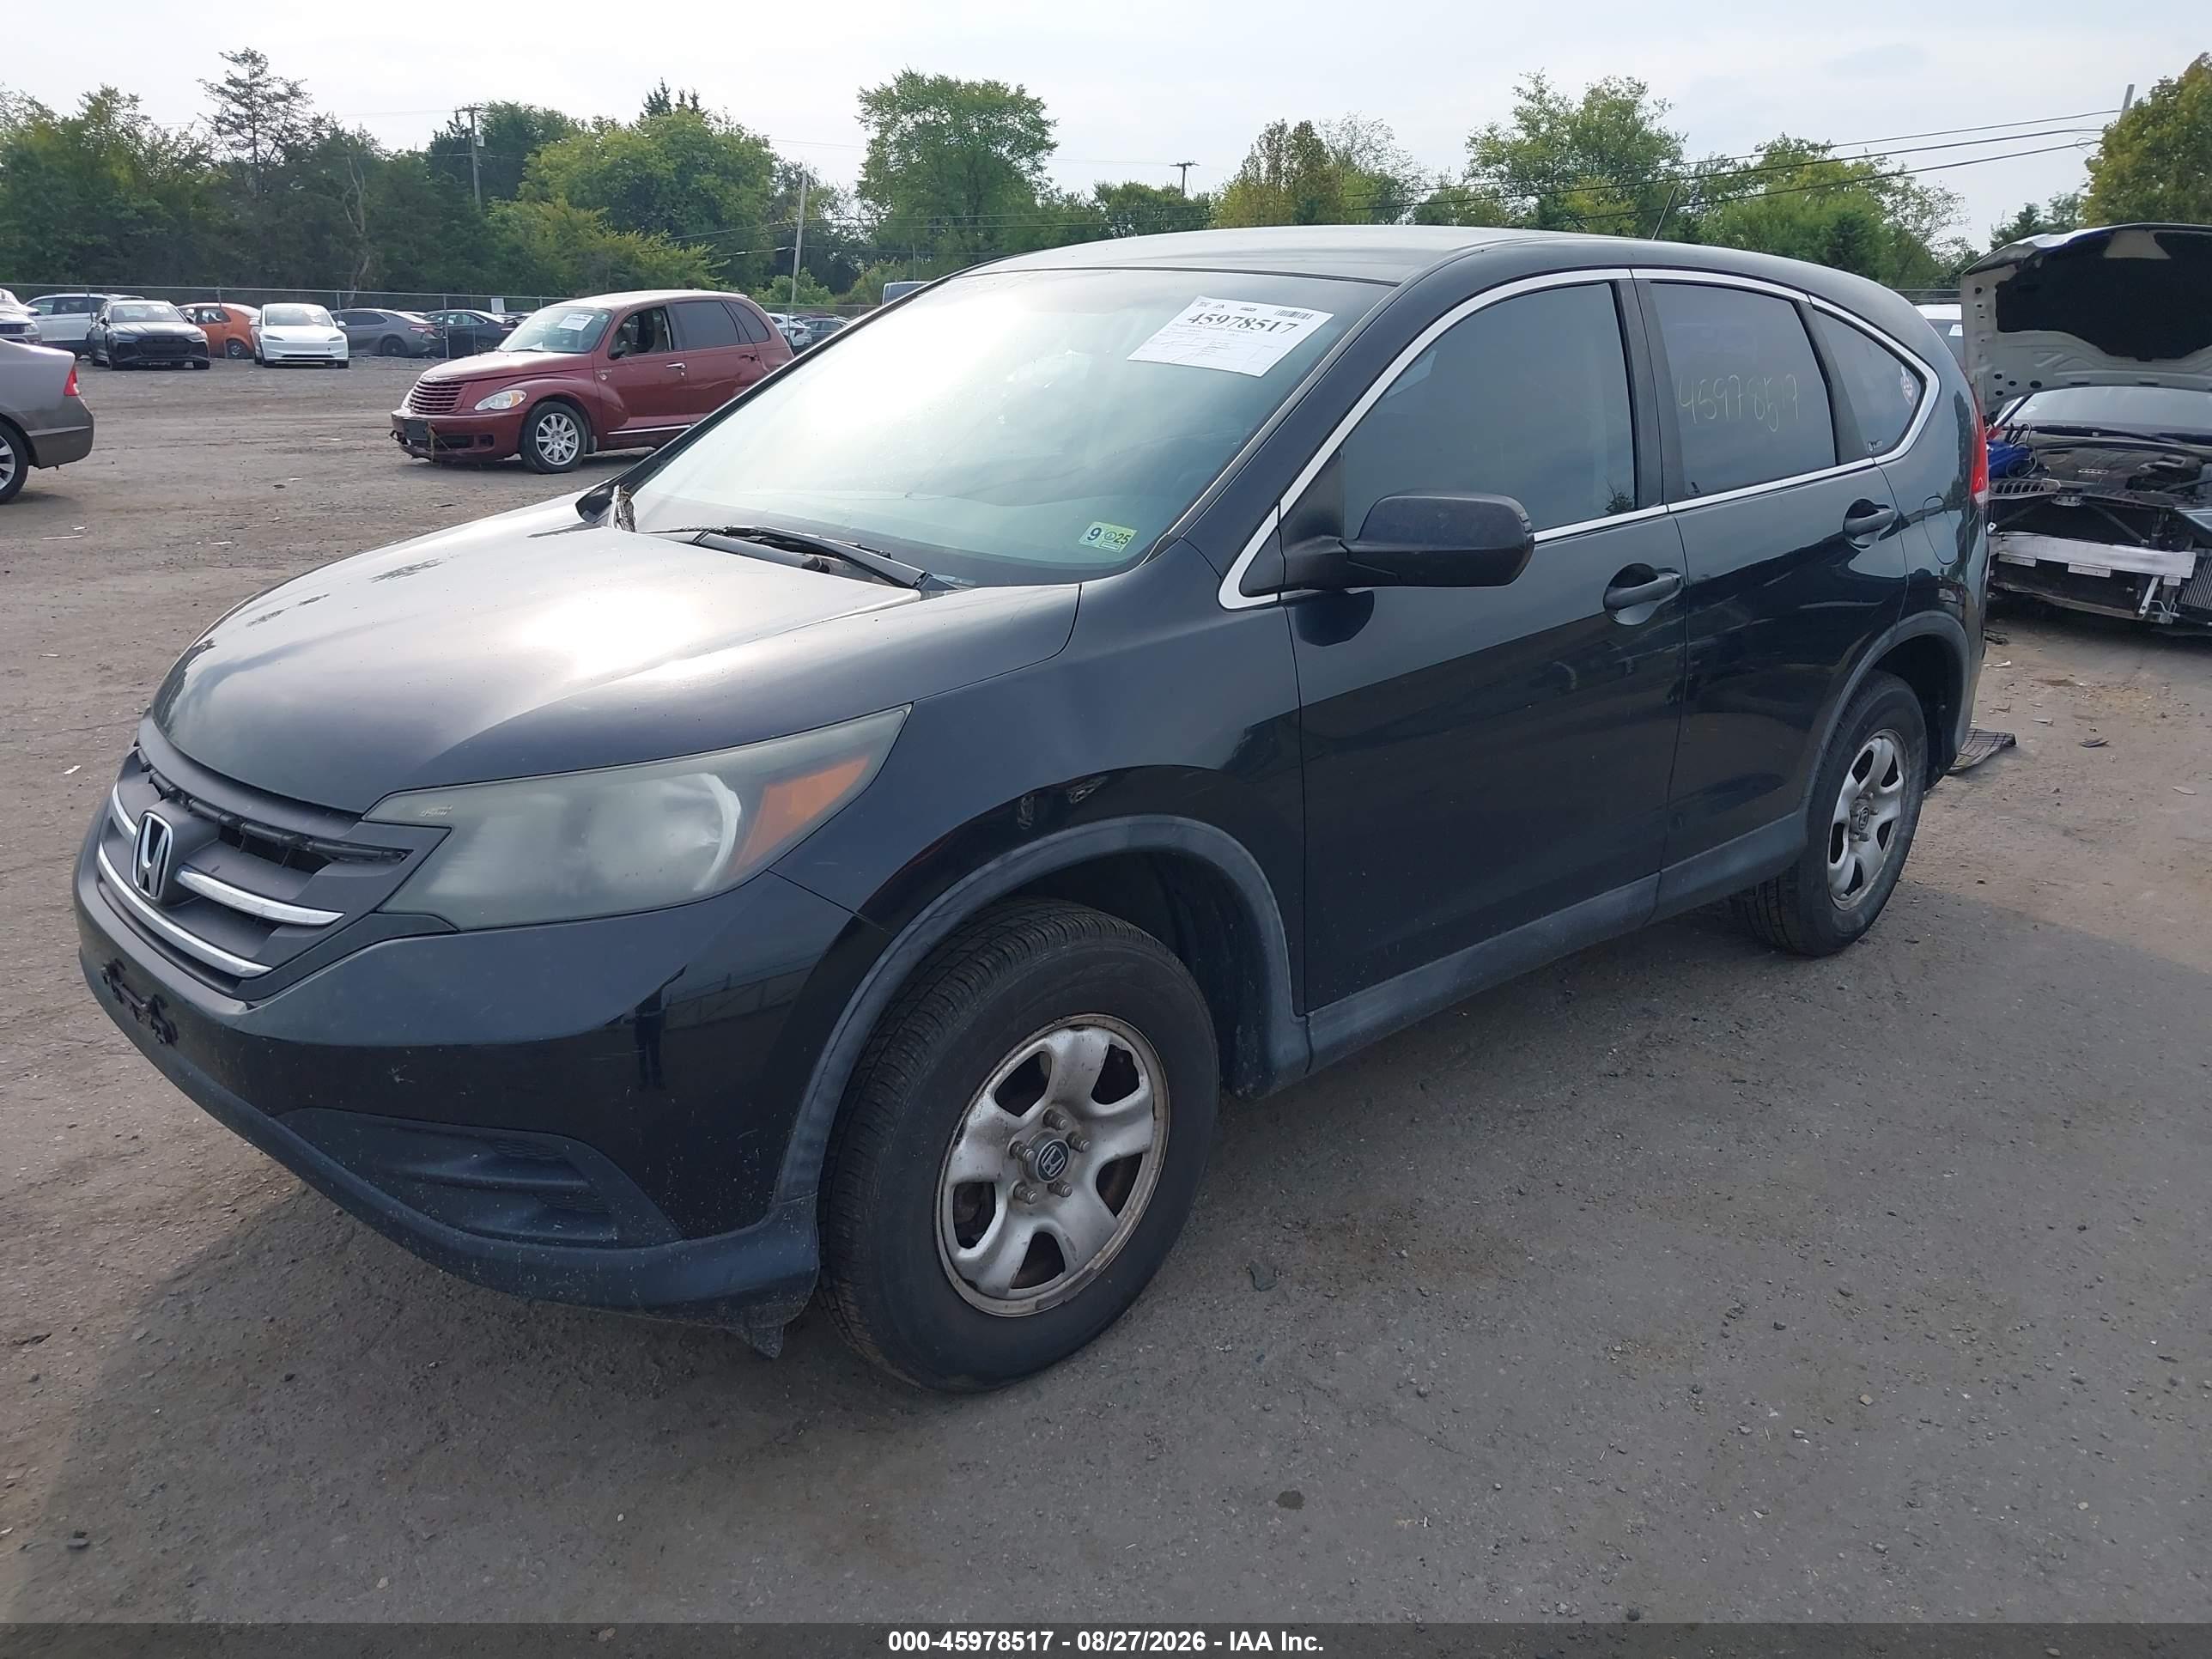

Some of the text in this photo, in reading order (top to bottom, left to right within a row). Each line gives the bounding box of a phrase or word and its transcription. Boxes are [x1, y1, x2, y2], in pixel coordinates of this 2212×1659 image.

[1187, 312, 1299, 336] 45978517
[1086, 526, 1103, 541] 9
[1112, 532, 1132, 544] 25
